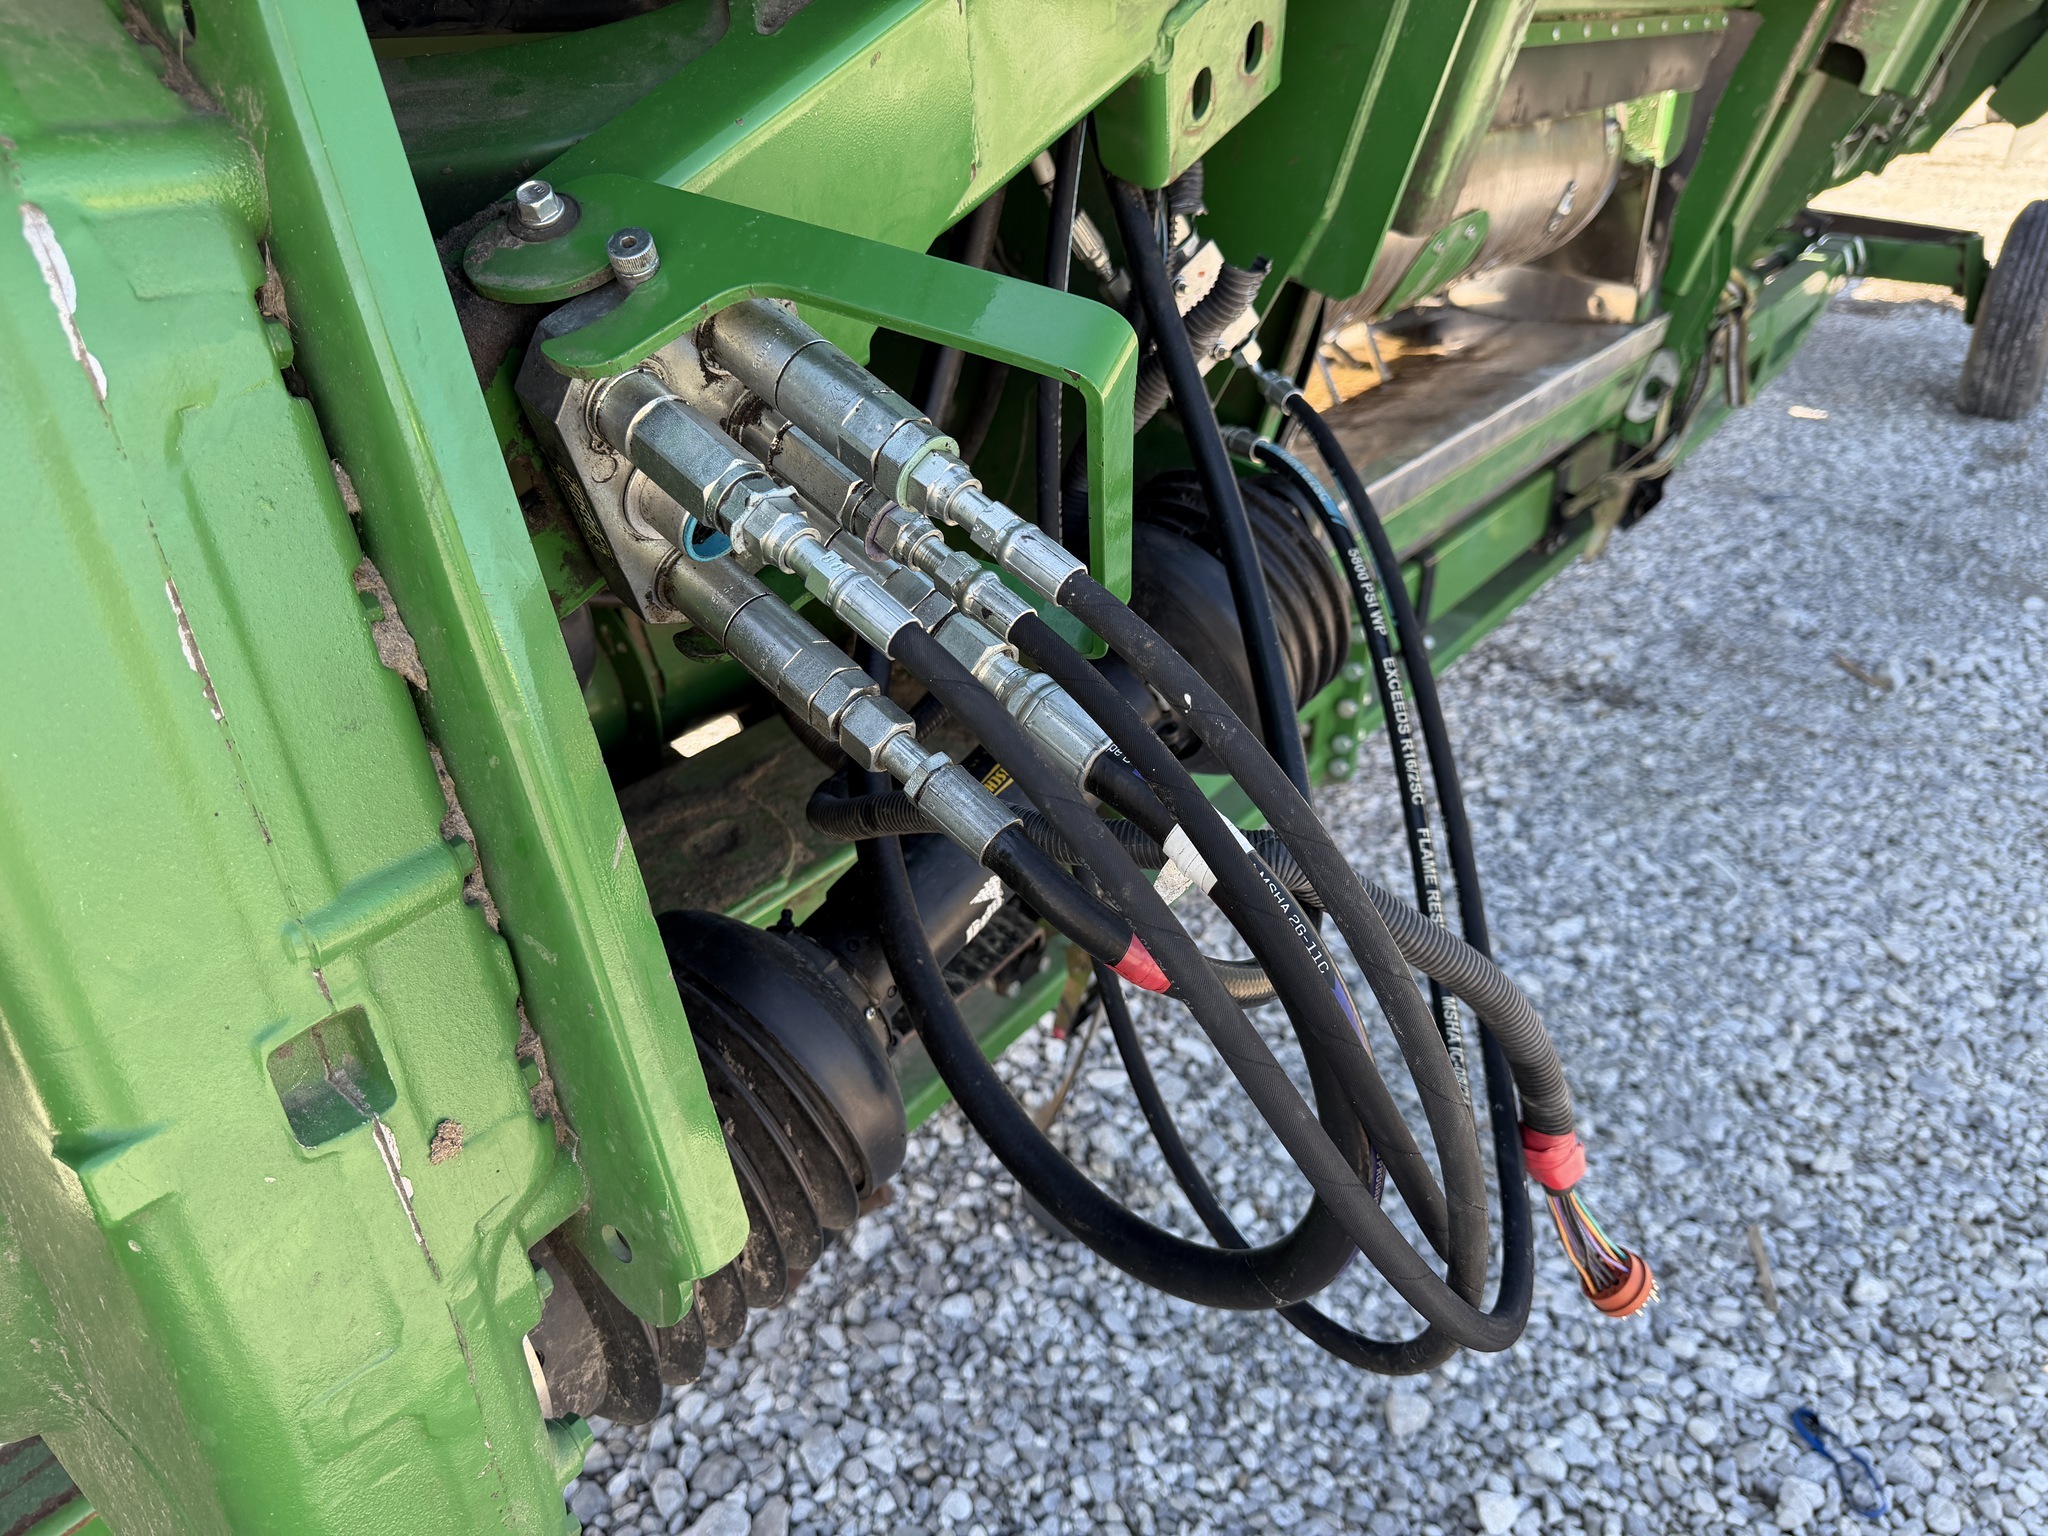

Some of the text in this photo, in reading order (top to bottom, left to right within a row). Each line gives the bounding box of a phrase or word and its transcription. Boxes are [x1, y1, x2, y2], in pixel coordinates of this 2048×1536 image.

[1361, 582, 1380, 611] PSI
[1370, 606, 1388, 637] WP
[1381, 656, 1411, 737] EXCEEDS
[1399, 736, 1426, 807] R16/2SC
[1416, 827, 1438, 889] FLAME
[1258, 870, 1330, 976] MSHA 2G-11C
[1425, 889, 1446, 931] RES
[1440, 995, 1462, 1043] MSHA
